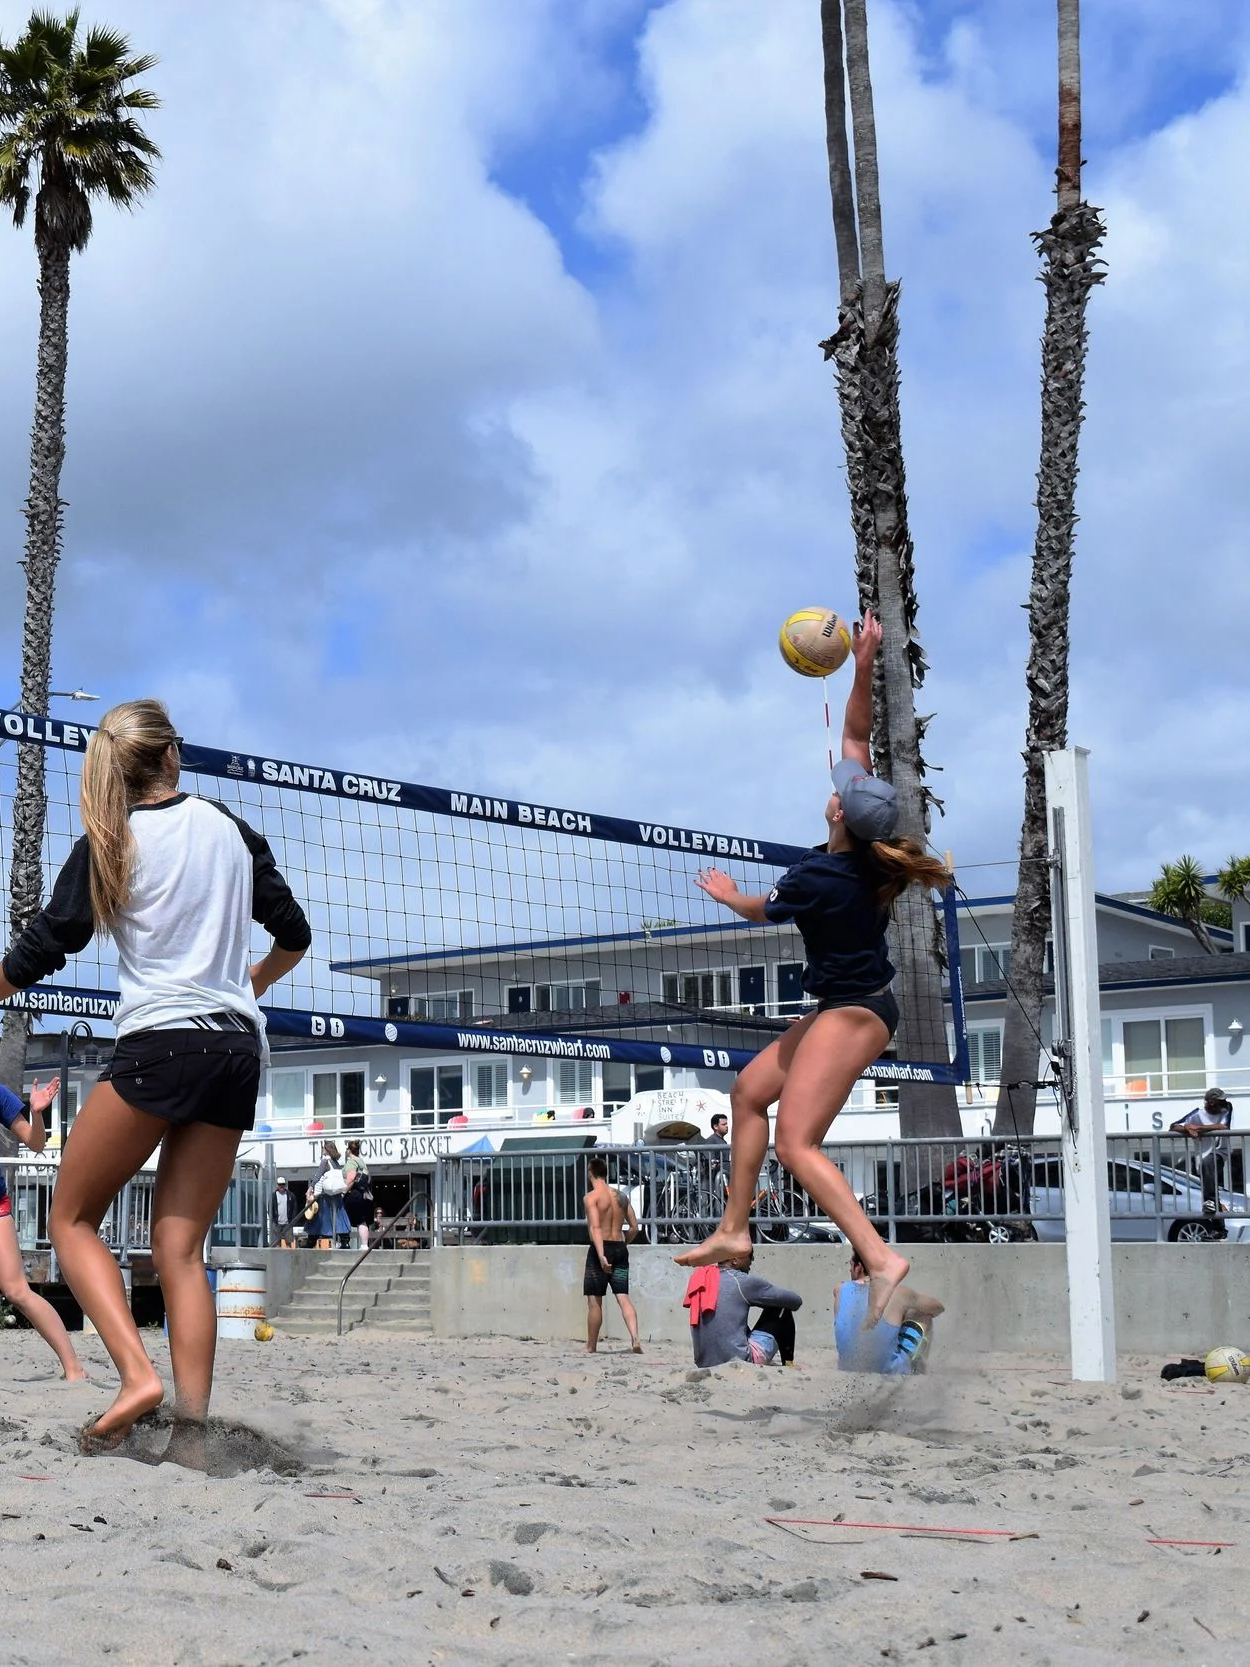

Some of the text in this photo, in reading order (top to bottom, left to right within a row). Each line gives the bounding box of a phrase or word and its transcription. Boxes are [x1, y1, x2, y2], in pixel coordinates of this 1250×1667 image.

[261, 760, 337, 791] SANTA
[342, 774, 401, 802] CRUZ
[450, 793, 508, 819] MAIN
[517, 804, 592, 833] BEACH
[638, 824, 764, 860] VOLLEYBALL
[0, 990, 120, 1016] w.santacruzw
[456, 1033, 611, 1059] www.santacruzwharf.com
[862, 1063, 934, 1081] acruzwharf.com
[657, 1091, 684, 1099] BEACH
[658, 1112, 684, 1121] SUITES
[345, 1138, 393, 1163] CNIC
[399, 1135, 452, 1160] BASKET
